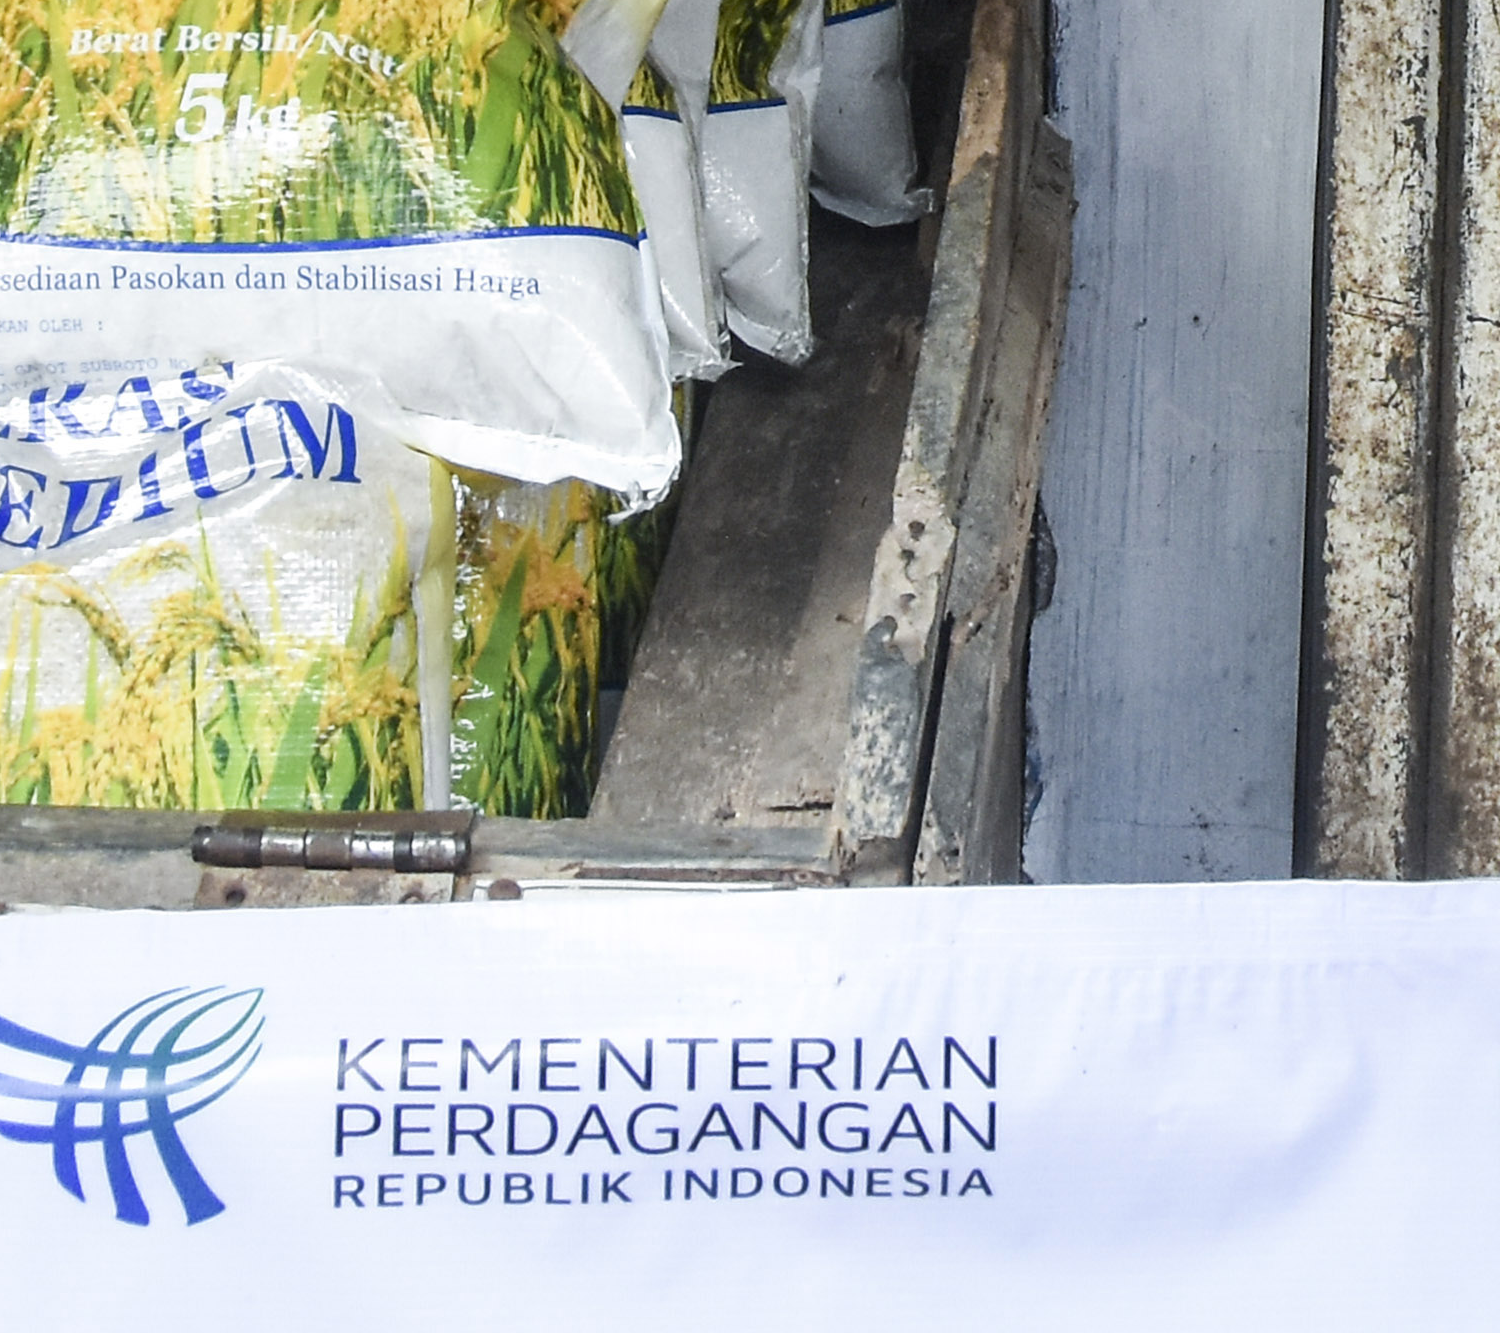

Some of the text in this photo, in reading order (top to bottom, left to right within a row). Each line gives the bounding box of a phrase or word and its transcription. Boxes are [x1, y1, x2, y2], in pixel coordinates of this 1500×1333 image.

[69, 28, 165, 56] Berat
[174, 72, 228, 143] 5
[111, 264, 224, 292] Pasokan
[235, 264, 286, 291] dan
[296, 265, 442, 293] Stabilisasi
[453, 267, 541, 298] Harga
[39, 318, 83, 334] OLEH
[80, 357, 158, 374] SUBROTO
[334, 1035, 999, 1092] KEMENTERIAN
[333, 1100, 999, 1158] PERDAGANGAN
[333, 1166, 995, 1208] REPUBLIK INDONESIA
